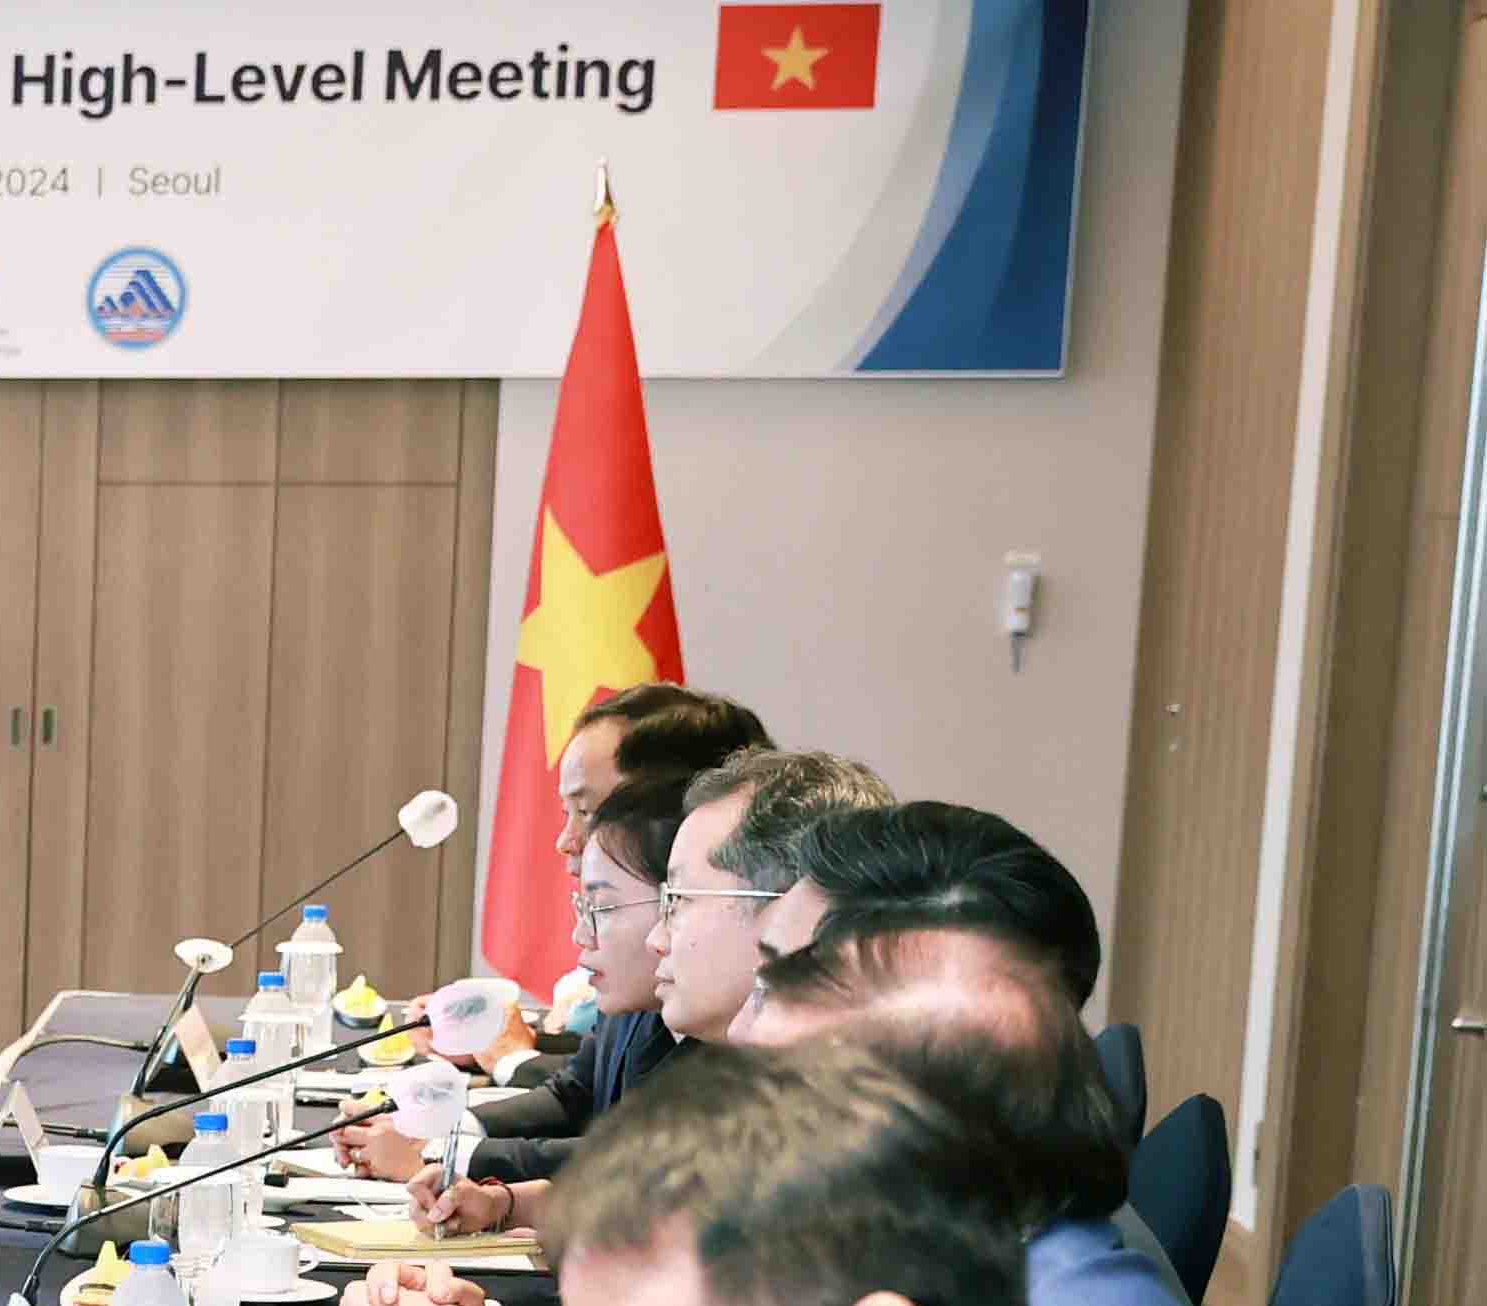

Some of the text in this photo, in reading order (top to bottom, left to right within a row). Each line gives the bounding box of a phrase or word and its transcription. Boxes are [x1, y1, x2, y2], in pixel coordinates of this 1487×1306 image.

[11, 49, 366, 120] High-Level
[384, 43, 657, 115] Meeting
[127, 166, 222, 197] Seoul
